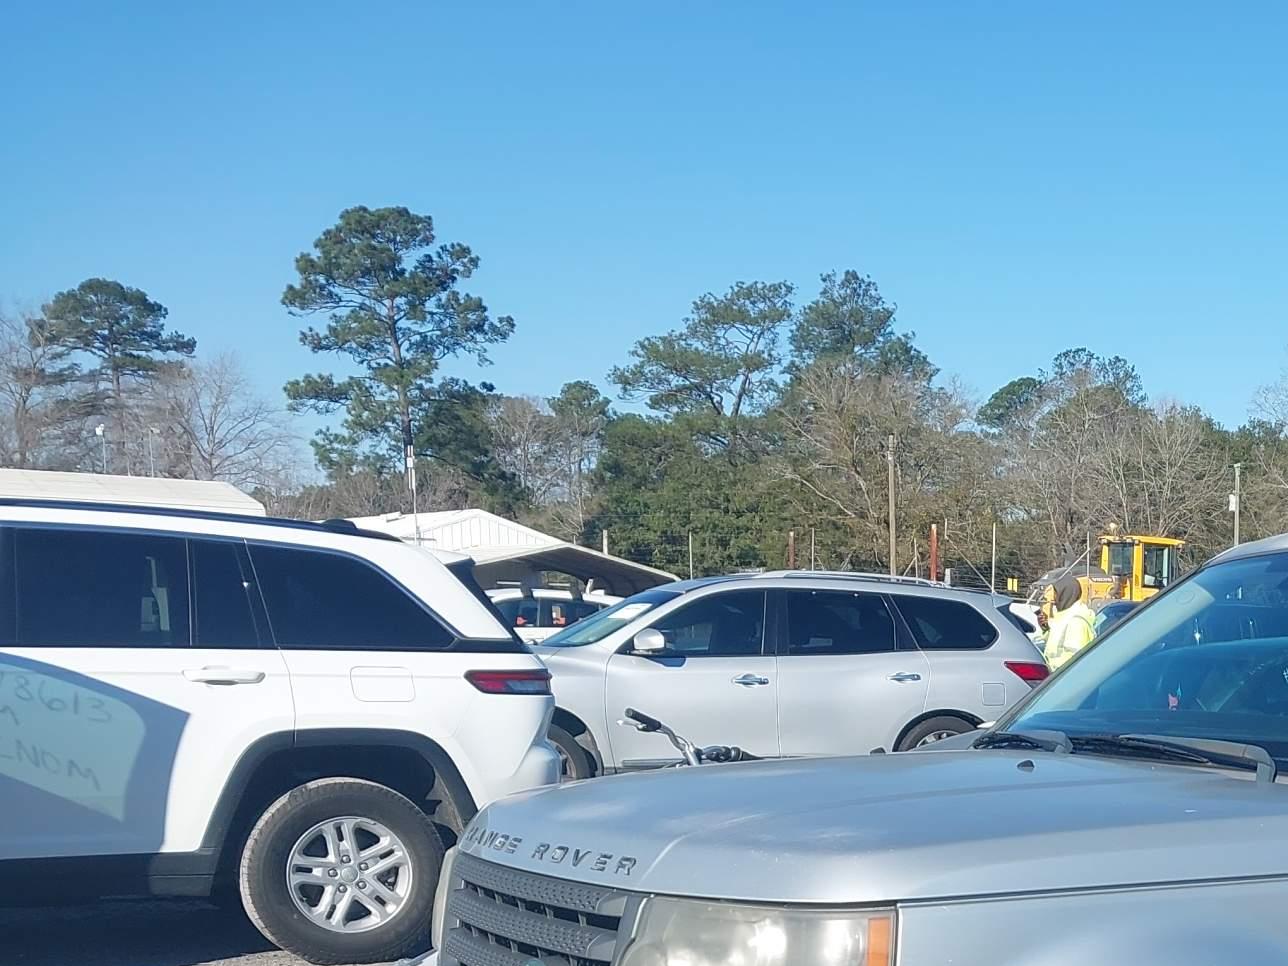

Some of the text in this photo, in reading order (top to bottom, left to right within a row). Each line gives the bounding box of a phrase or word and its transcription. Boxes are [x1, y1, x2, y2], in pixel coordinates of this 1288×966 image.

[0, 672, 112, 722] 8613
[466, 826, 637, 876] RANGE ROVER
